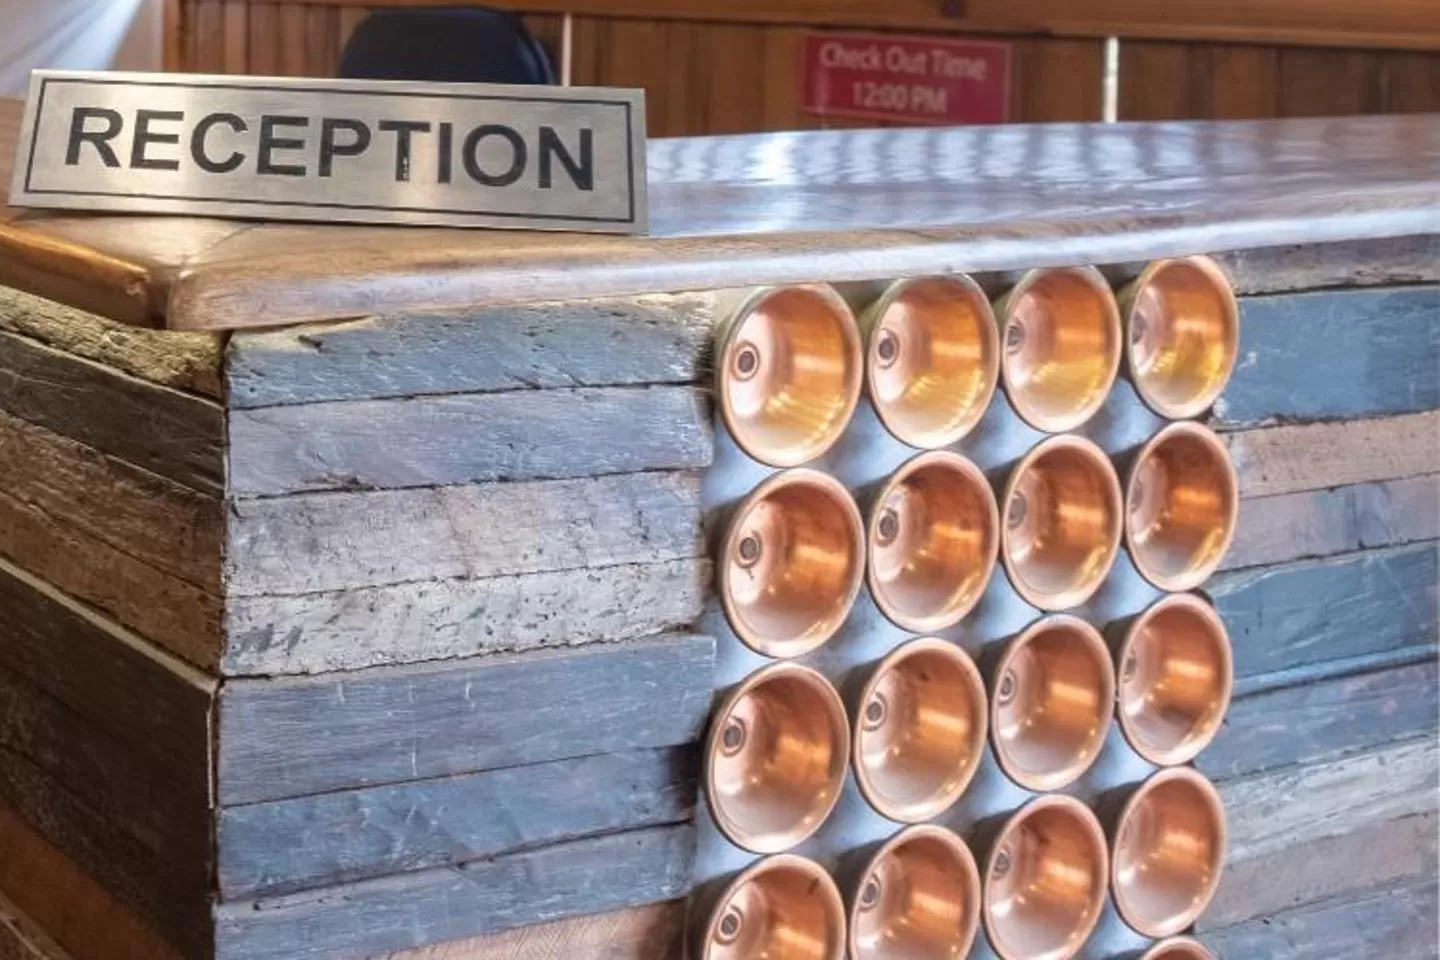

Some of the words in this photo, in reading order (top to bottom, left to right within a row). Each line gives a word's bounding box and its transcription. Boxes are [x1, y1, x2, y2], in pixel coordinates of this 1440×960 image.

[818, 41, 882, 71] Check
[886, 46, 927, 74] Out
[931, 49, 988, 80] Time
[852, 81, 907, 109] 12:00
[911, 85, 948, 114] PM
[65, 106, 595, 191] RECEPTION
